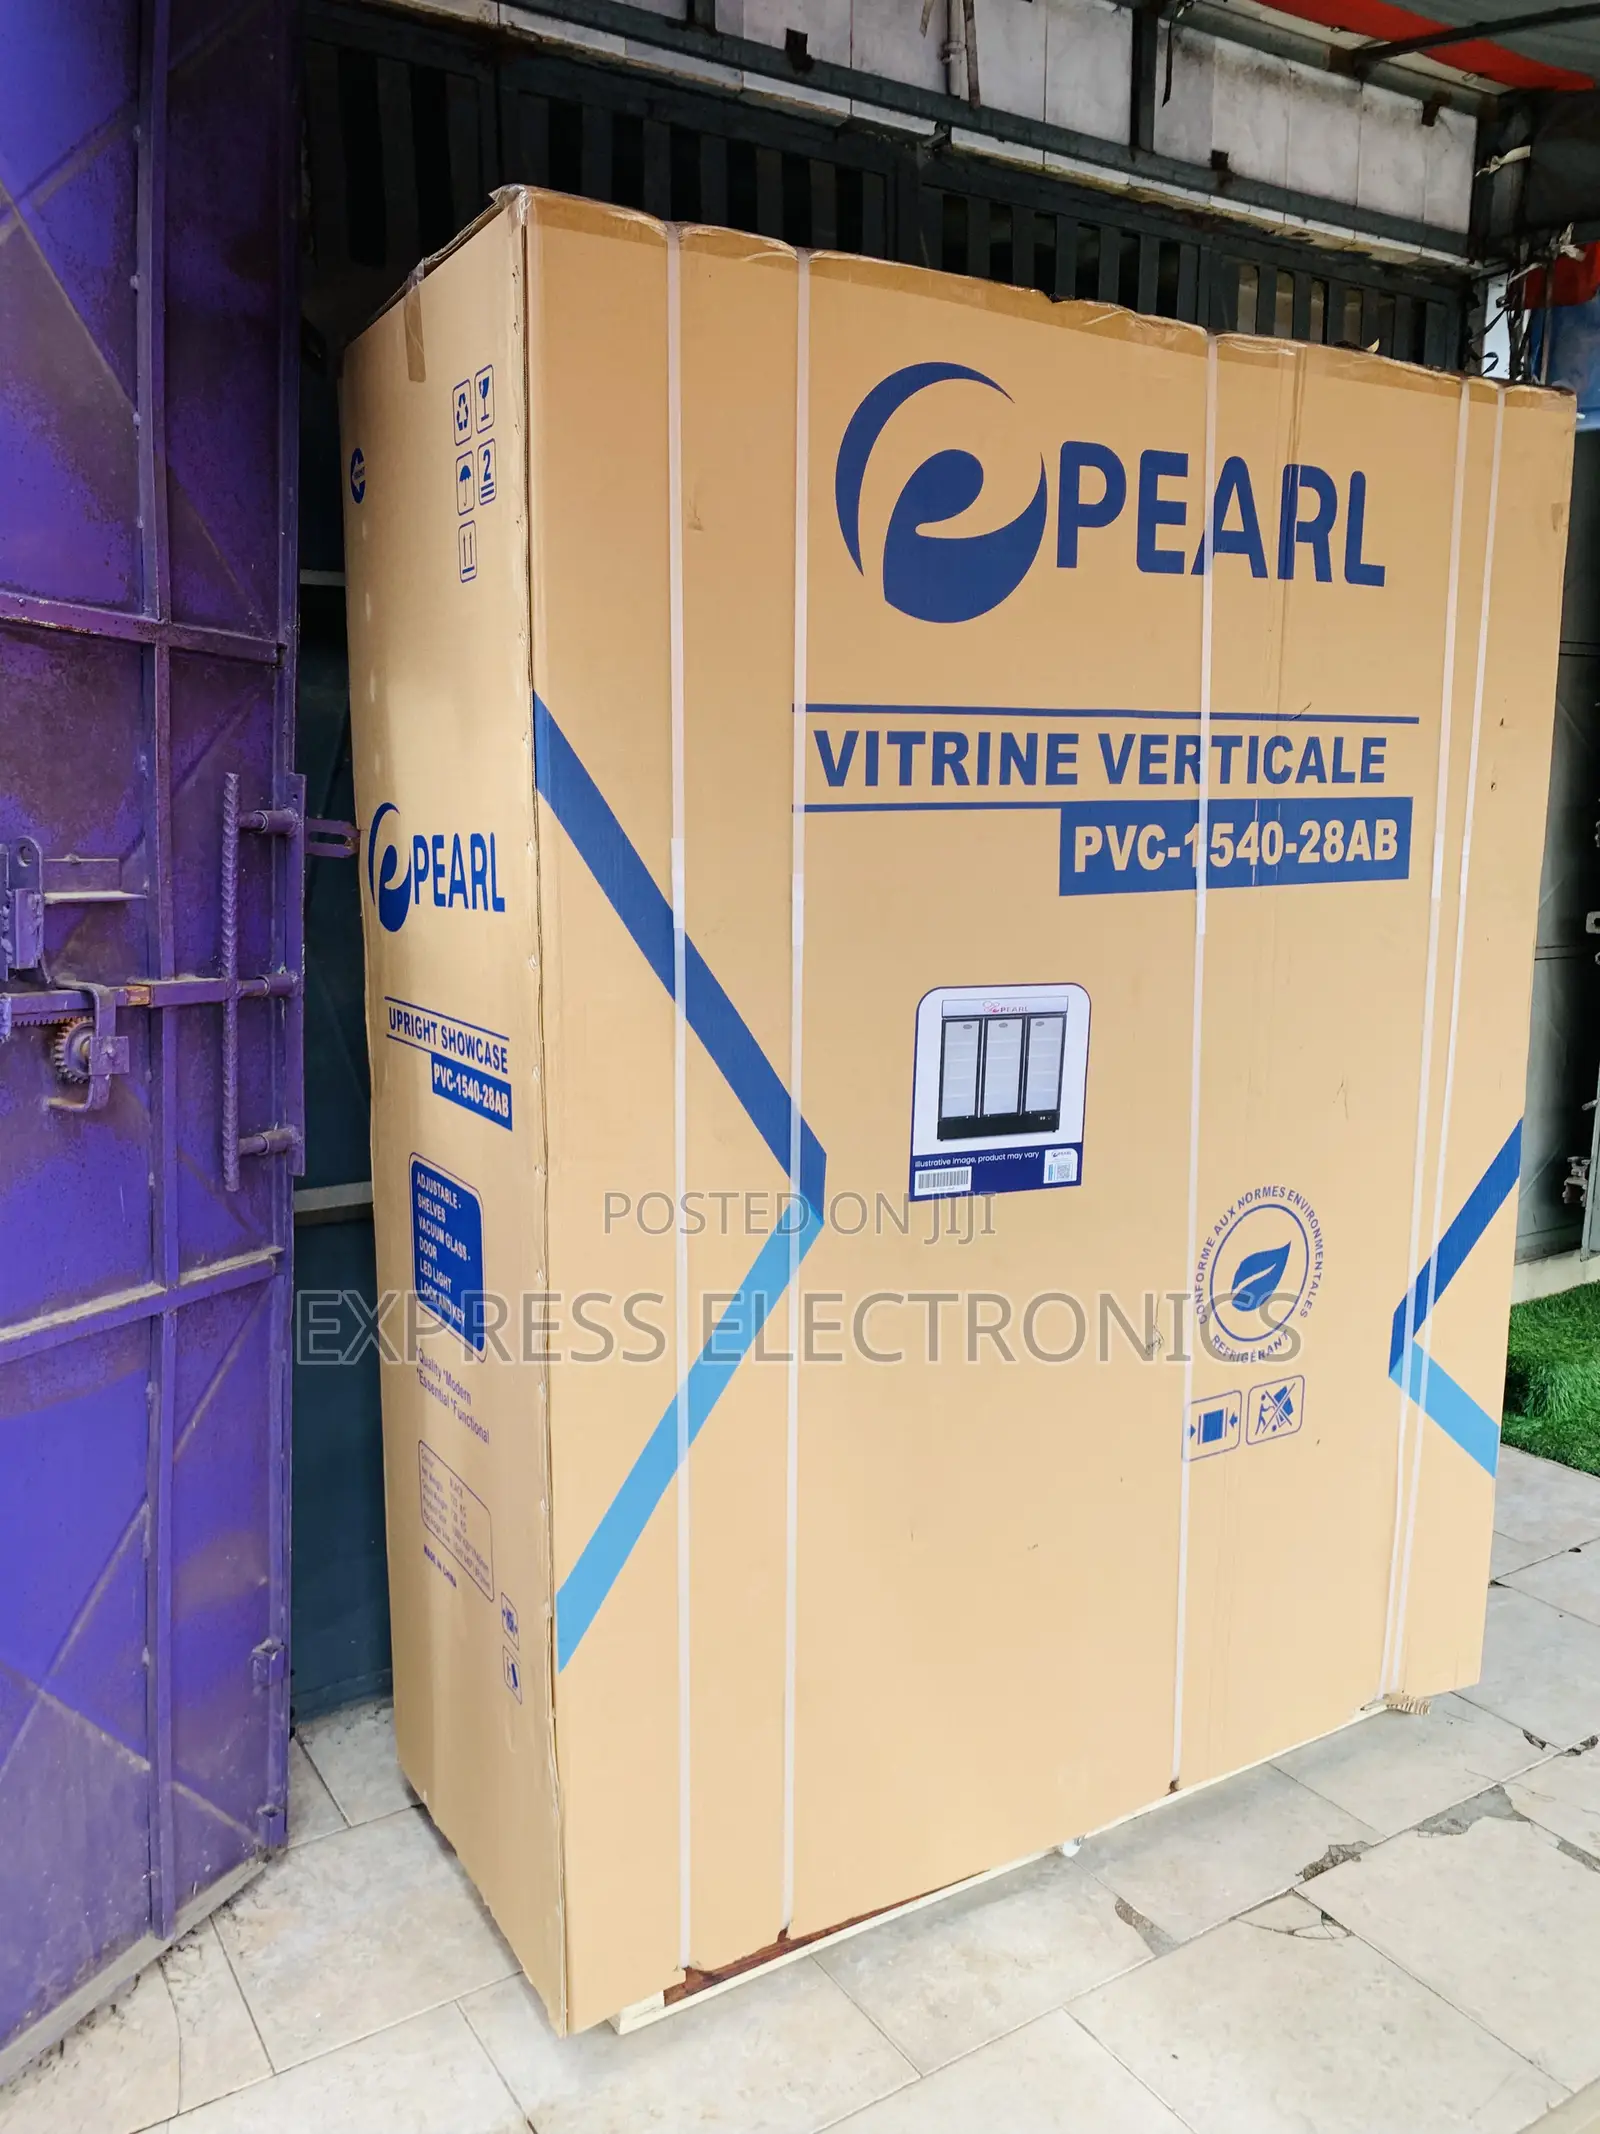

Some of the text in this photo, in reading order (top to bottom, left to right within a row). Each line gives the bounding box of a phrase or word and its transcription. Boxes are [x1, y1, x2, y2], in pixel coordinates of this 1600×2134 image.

[483, 449, 491, 482] 2
[1056, 441, 1386, 588] PEARL
[813, 730, 1388, 788] VITRINE VERTICALE
[1073, 819, 1399, 873] PVC-1540-28AB
[412, 831, 506, 913] PEARL
[388, 1006, 509, 1075] UPRIGHT SHOWCASE
[433, 1062, 510, 1119] PVC-1540-28AB
[977, 1154, 1006, 1164] product
[1007, 1153, 1023, 1161] may
[1024, 1151, 1040, 1160] vary
[417, 1192, 446, 1224] SHELVES
[418, 1213, 445, 1246] VACUUM
[418, 1235, 438, 1262] DOOR
[1195, 1185, 1323, 1325] CONFORME AUX NORMES ENVIRONMENTALES
[419, 1256, 452, 1294] LED LIGHT
[452, 1303, 466, 1327] KEY
